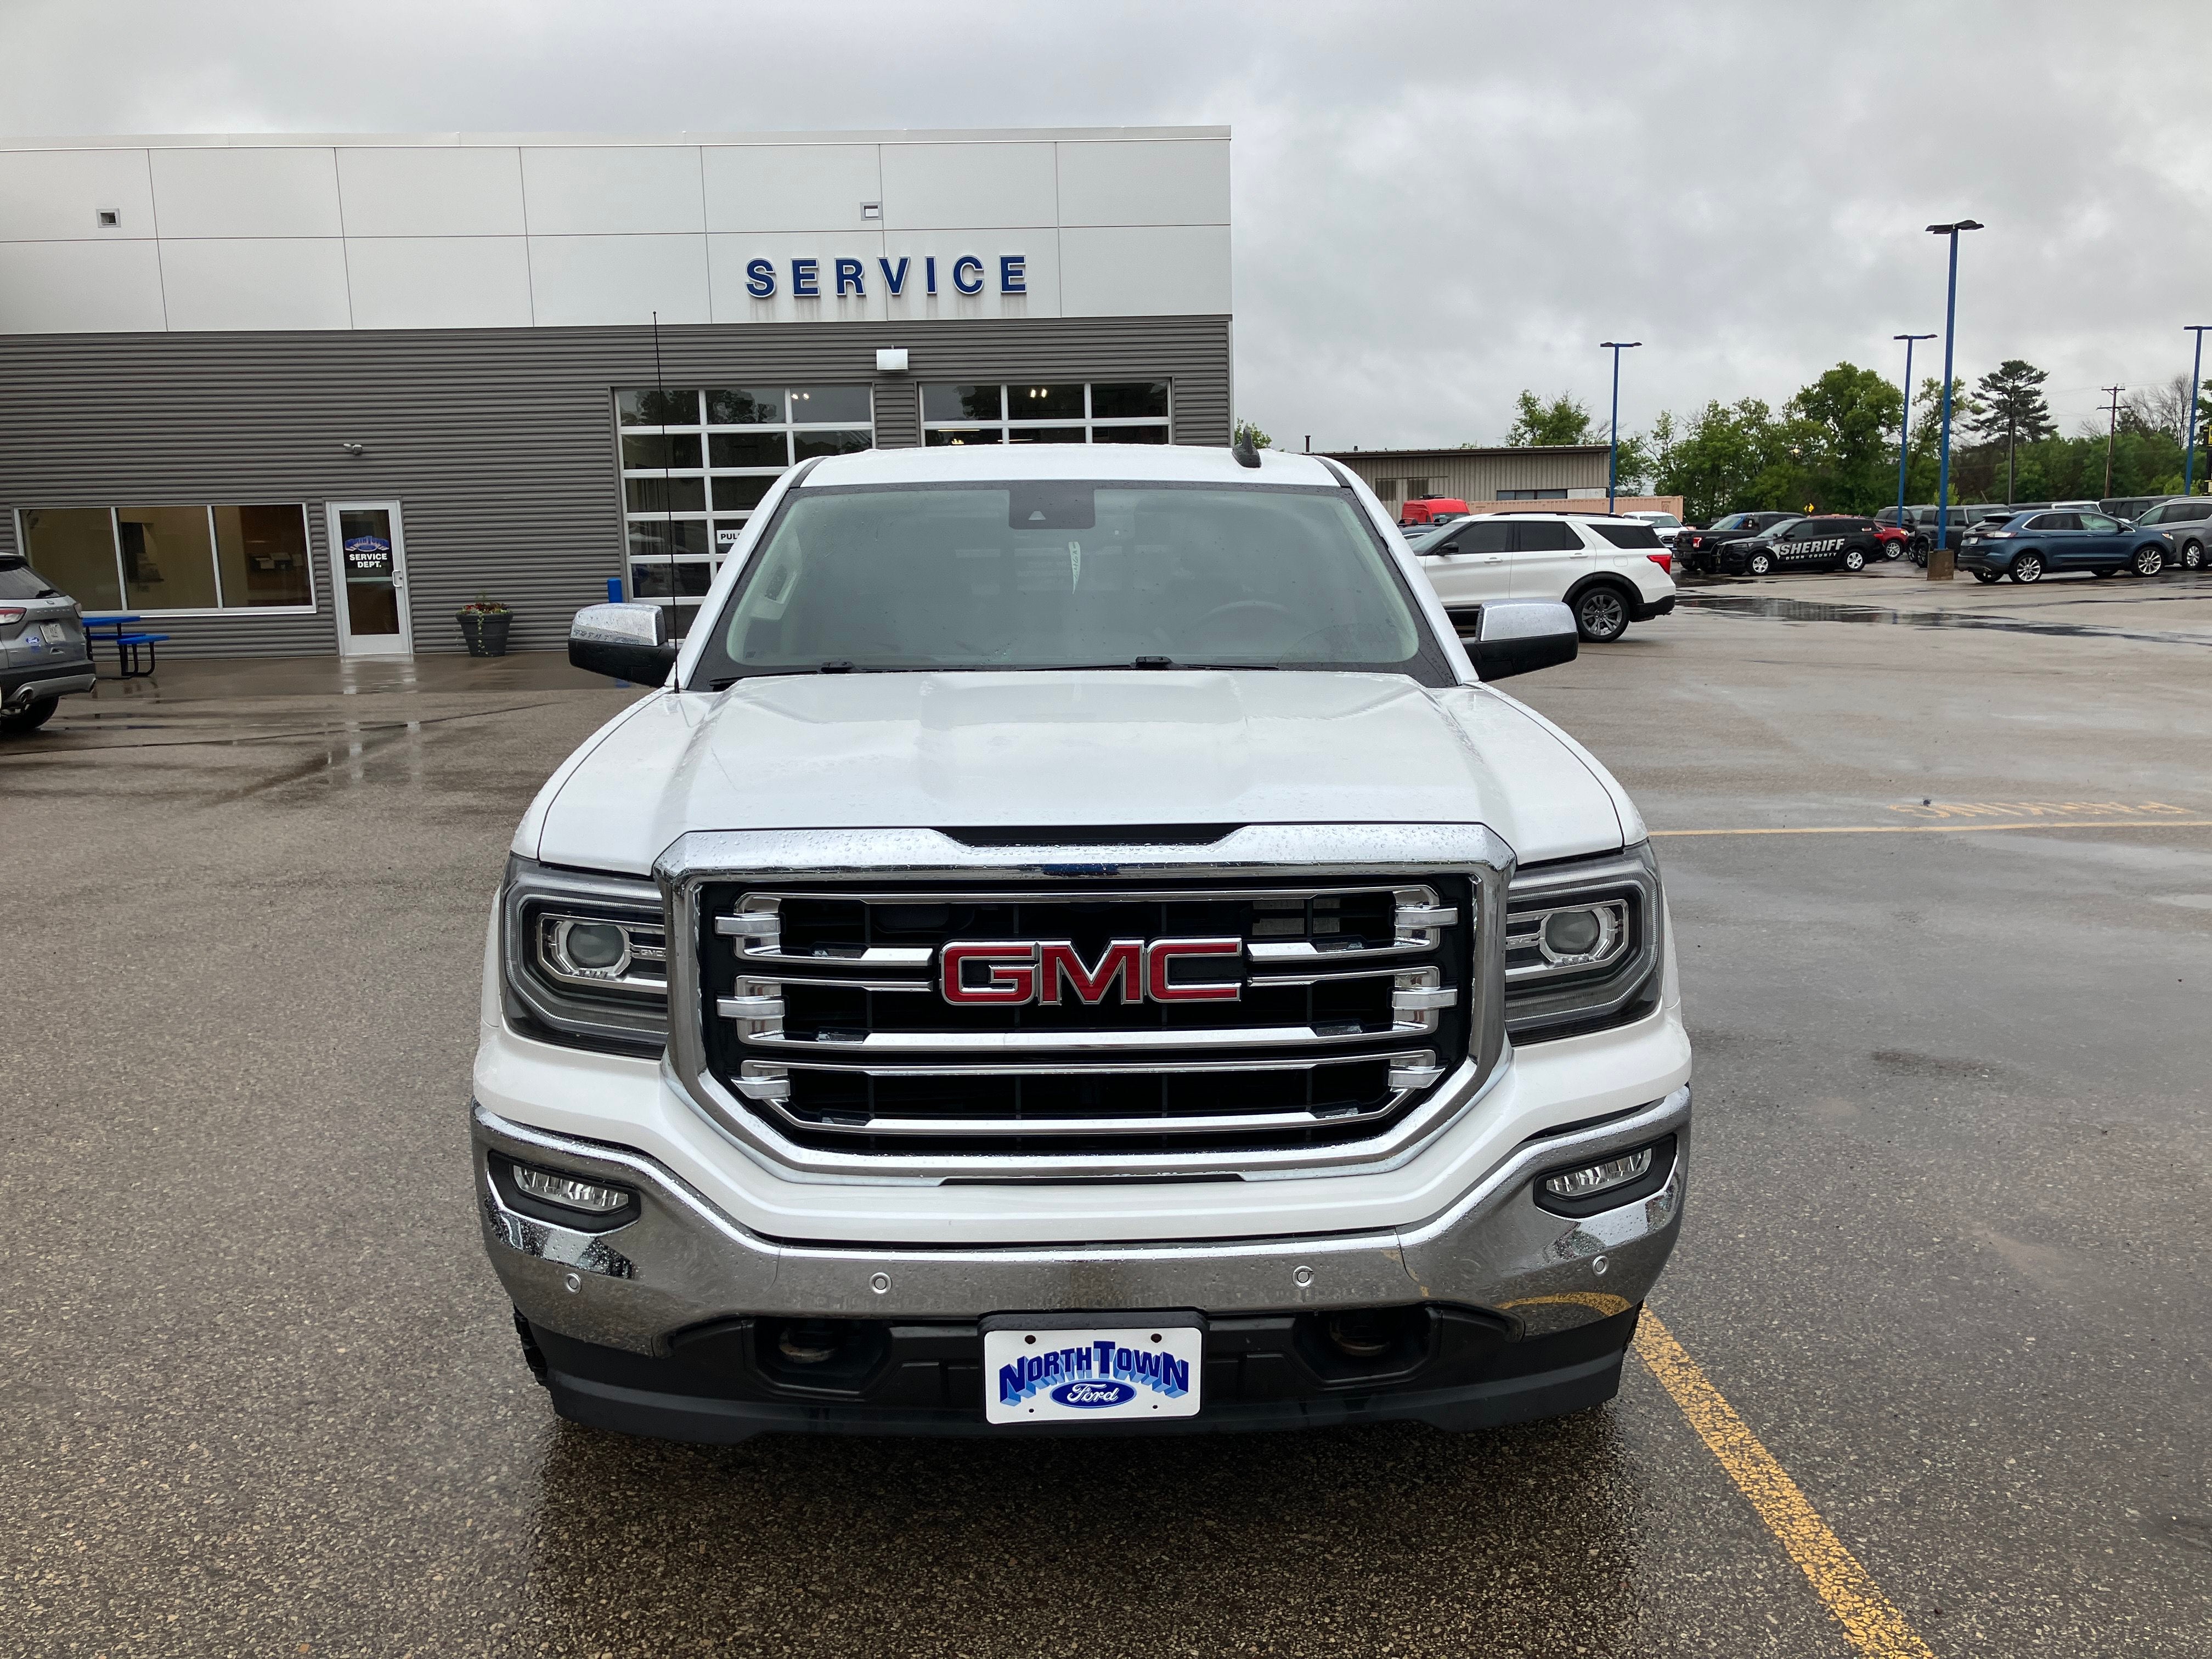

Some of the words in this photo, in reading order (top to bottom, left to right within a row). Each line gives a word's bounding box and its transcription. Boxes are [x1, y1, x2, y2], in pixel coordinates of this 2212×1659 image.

[745, 255, 1027, 298] SERVICE
[1780, 539, 1845, 555] SHERIFF
[939, 935, 1242, 1006] GMC
[1066, 1383, 1119, 1403] Ford
